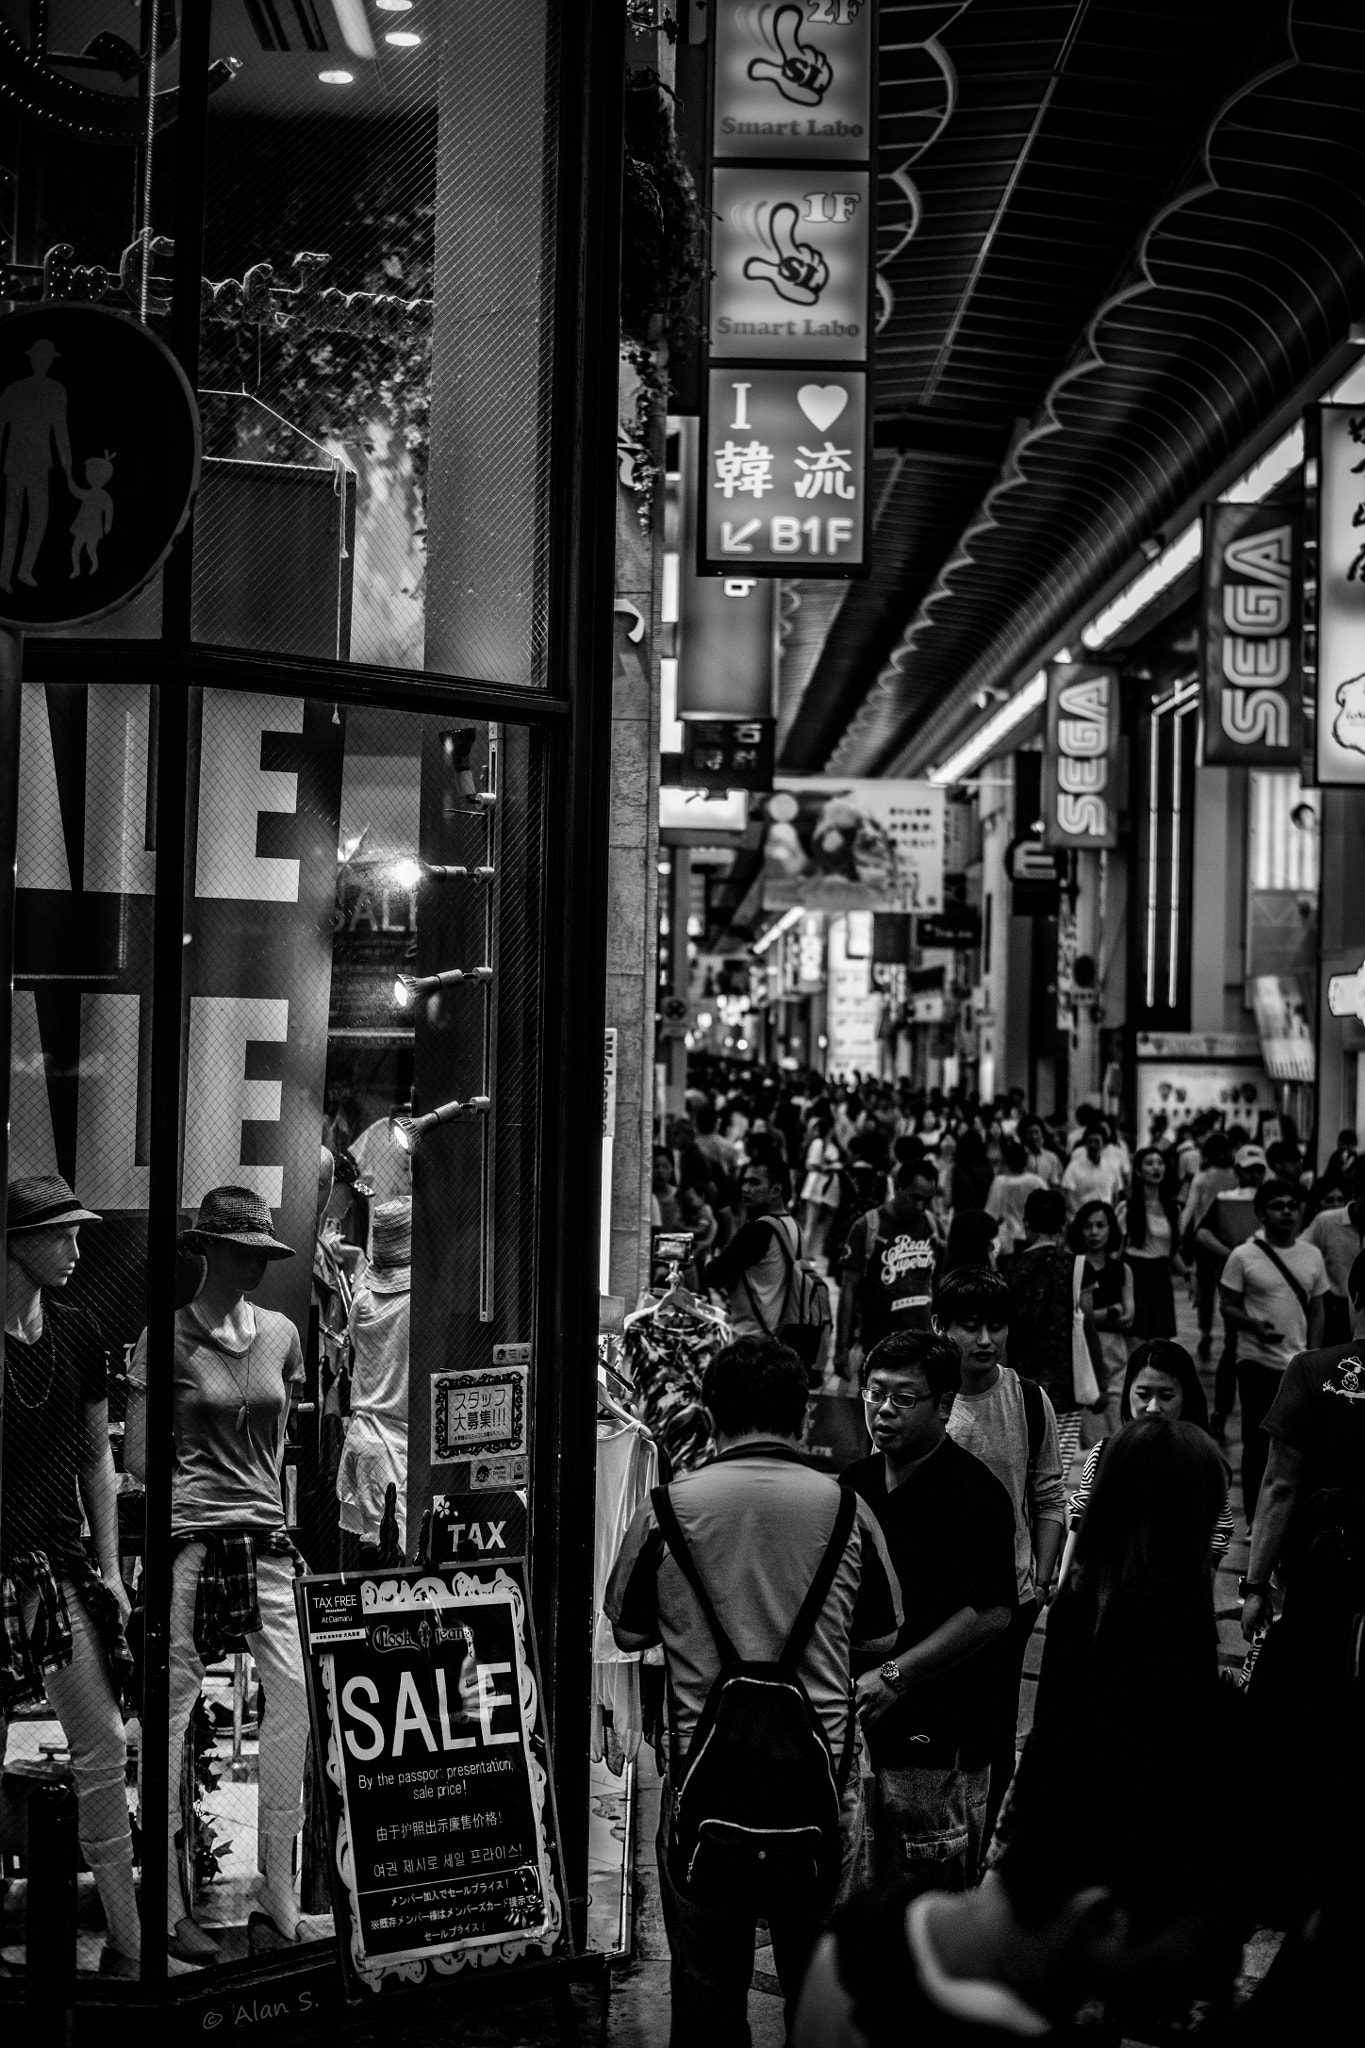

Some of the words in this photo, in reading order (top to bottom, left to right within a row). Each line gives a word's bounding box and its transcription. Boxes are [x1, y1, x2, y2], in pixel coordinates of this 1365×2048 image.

[806, 0, 863, 25] 2F
[720, 116, 800, 137] Smart
[806, 118, 864, 138] Labo
[803, 192, 861, 224] 1F
[715, 316, 798, 336] Smart
[802, 318, 861, 338] Labo
[730, 382, 752, 430] I
[713, 440, 856, 500] 韓流
[770, 516, 854, 555] B1F
[1221, 524, 1292, 747] SEGA
[1056, 675, 1110, 836] SEGA
[455, 1389, 505, 1411] スタッフ
[454, 1408, 506, 1432] 大募集!!!
[448, 1520, 507, 1553] TAX
[312, 1596, 333, 1609] TAX
[334, 1594, 358, 1608] FREE
[341, 1661, 521, 1761] SALE
[357, 1774, 373, 1790] By
[377, 1769, 395, 1787] the
[397, 1768, 444, 1786] passport
[413, 1783, 434, 1800] sale
[437, 1779, 467, 1799] price!
[443, 1851, 465, 1868] 세일
